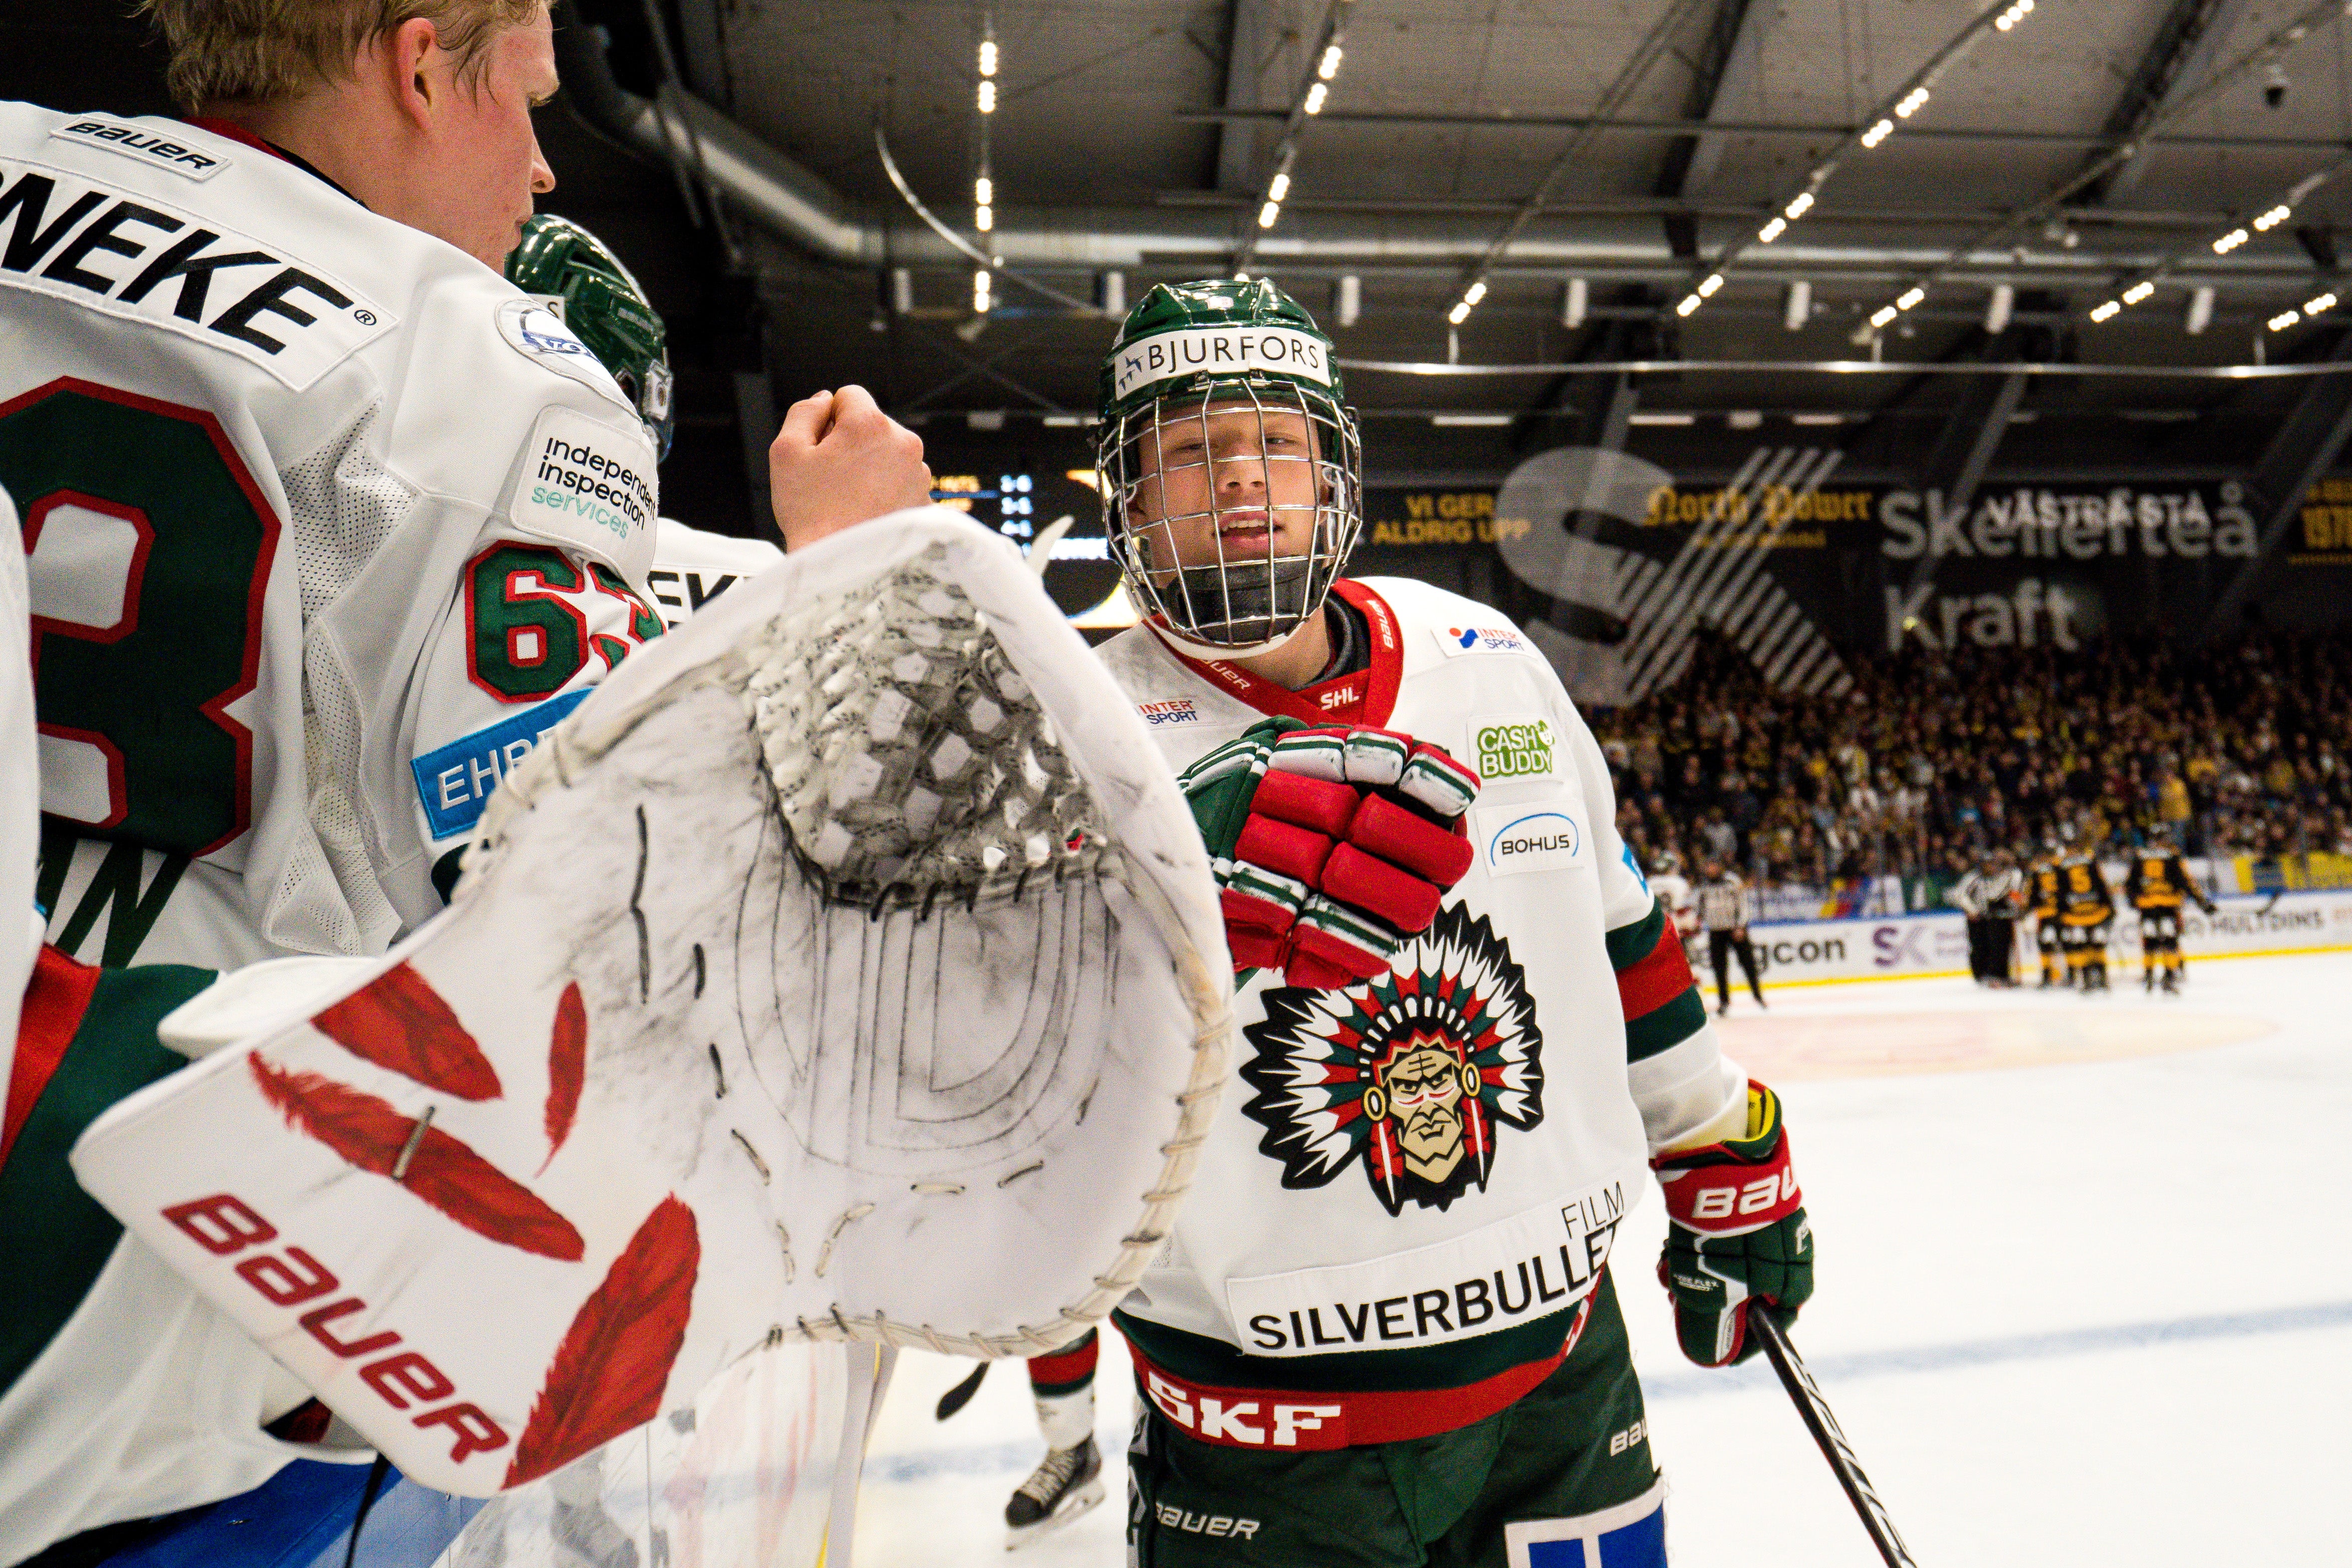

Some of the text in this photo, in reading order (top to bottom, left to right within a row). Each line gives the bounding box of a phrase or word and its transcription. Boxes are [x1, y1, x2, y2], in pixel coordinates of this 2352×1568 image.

[1147, 336, 1319, 374] BJURFORS
[537, 455, 646, 531] inspection
[545, 436, 656, 521] independent
[531, 486, 628, 540] services
[1405, 492, 1495, 517] VI GER
[1644, 485, 1875, 529] North Power
[1371, 519, 1473, 546] ALDRIG
[1884, 578, 2078, 652] Kraft
[1477, 627, 1517, 641] INTER
[1484, 638, 1525, 651] SPORT
[1139, 699, 1191, 716] INTER
[1320, 686, 1361, 711] SHL
[1145, 710, 1198, 725] SPORT
[1479, 726, 1537, 752] CASH
[1481, 748, 1553, 777] BUDDY
[1501, 834, 1570, 855] BOHUS
[1691, 1165, 1797, 1218] BAU
[1560, 1181, 1625, 1239] FILM
[1148, 1371, 1342, 1446] SKF
